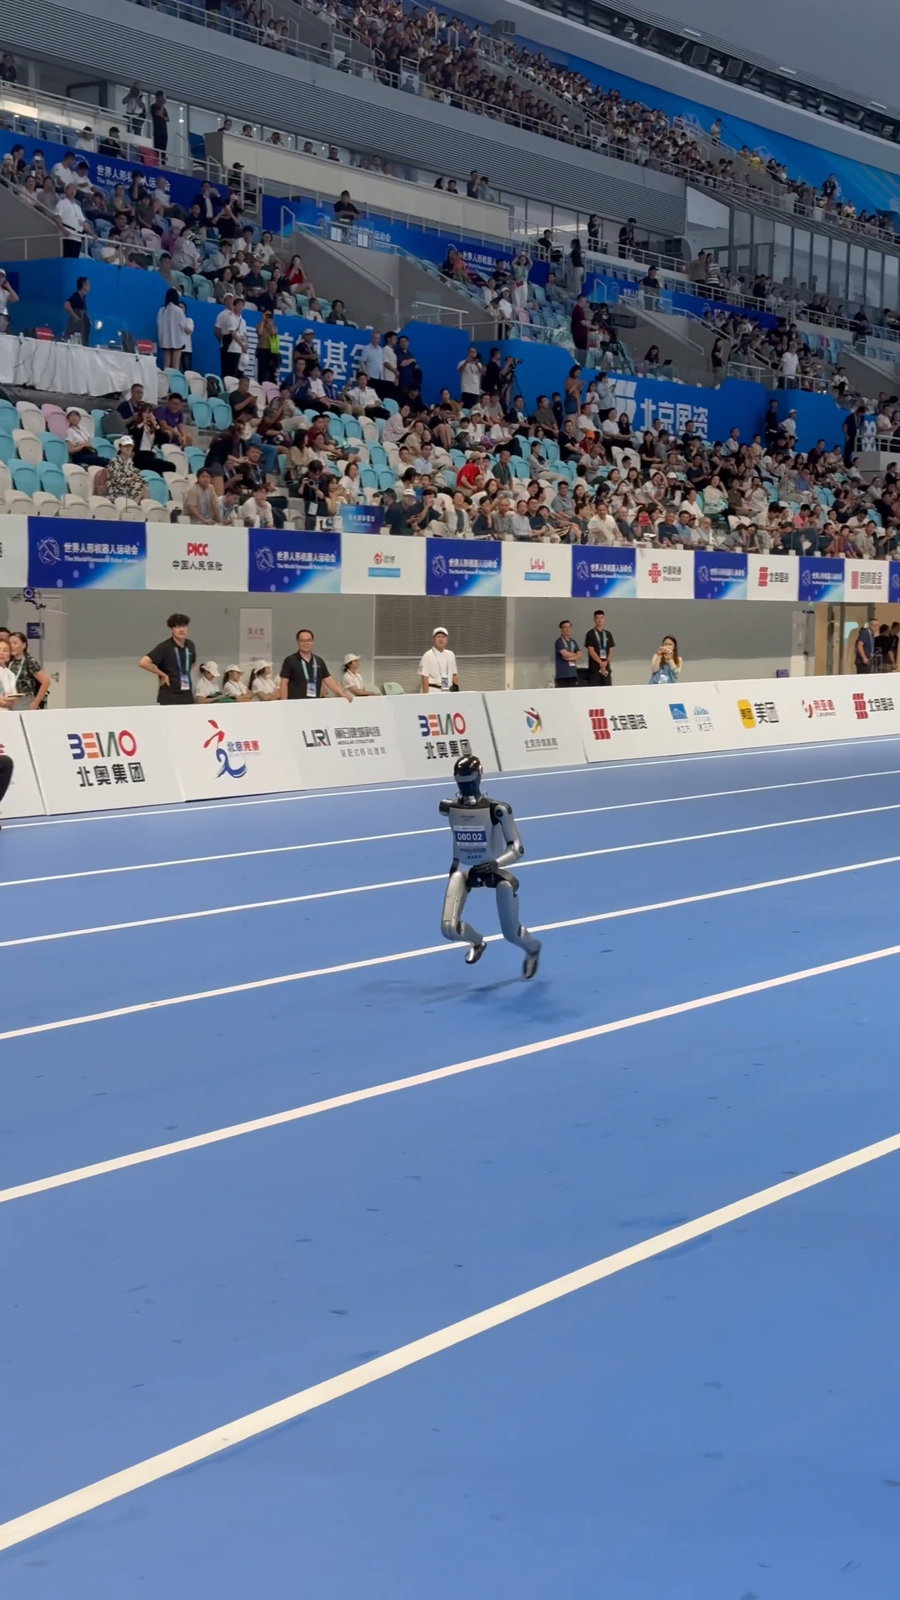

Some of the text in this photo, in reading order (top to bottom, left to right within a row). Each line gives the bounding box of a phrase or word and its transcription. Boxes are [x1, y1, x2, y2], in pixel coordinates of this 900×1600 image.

[640, 398, 708, 439] 北京国资
[64, 542, 138, 555] 世界人形机器人运动会
[187, 543, 208, 556] PICC
[173, 560, 223, 571] 中国人民保险
[754, 702, 780, 724] 美团
[610, 714, 648, 731] 北京国资
[425, 739, 472, 759] 北奥集团
[77, 762, 145, 787] 北奥集团
